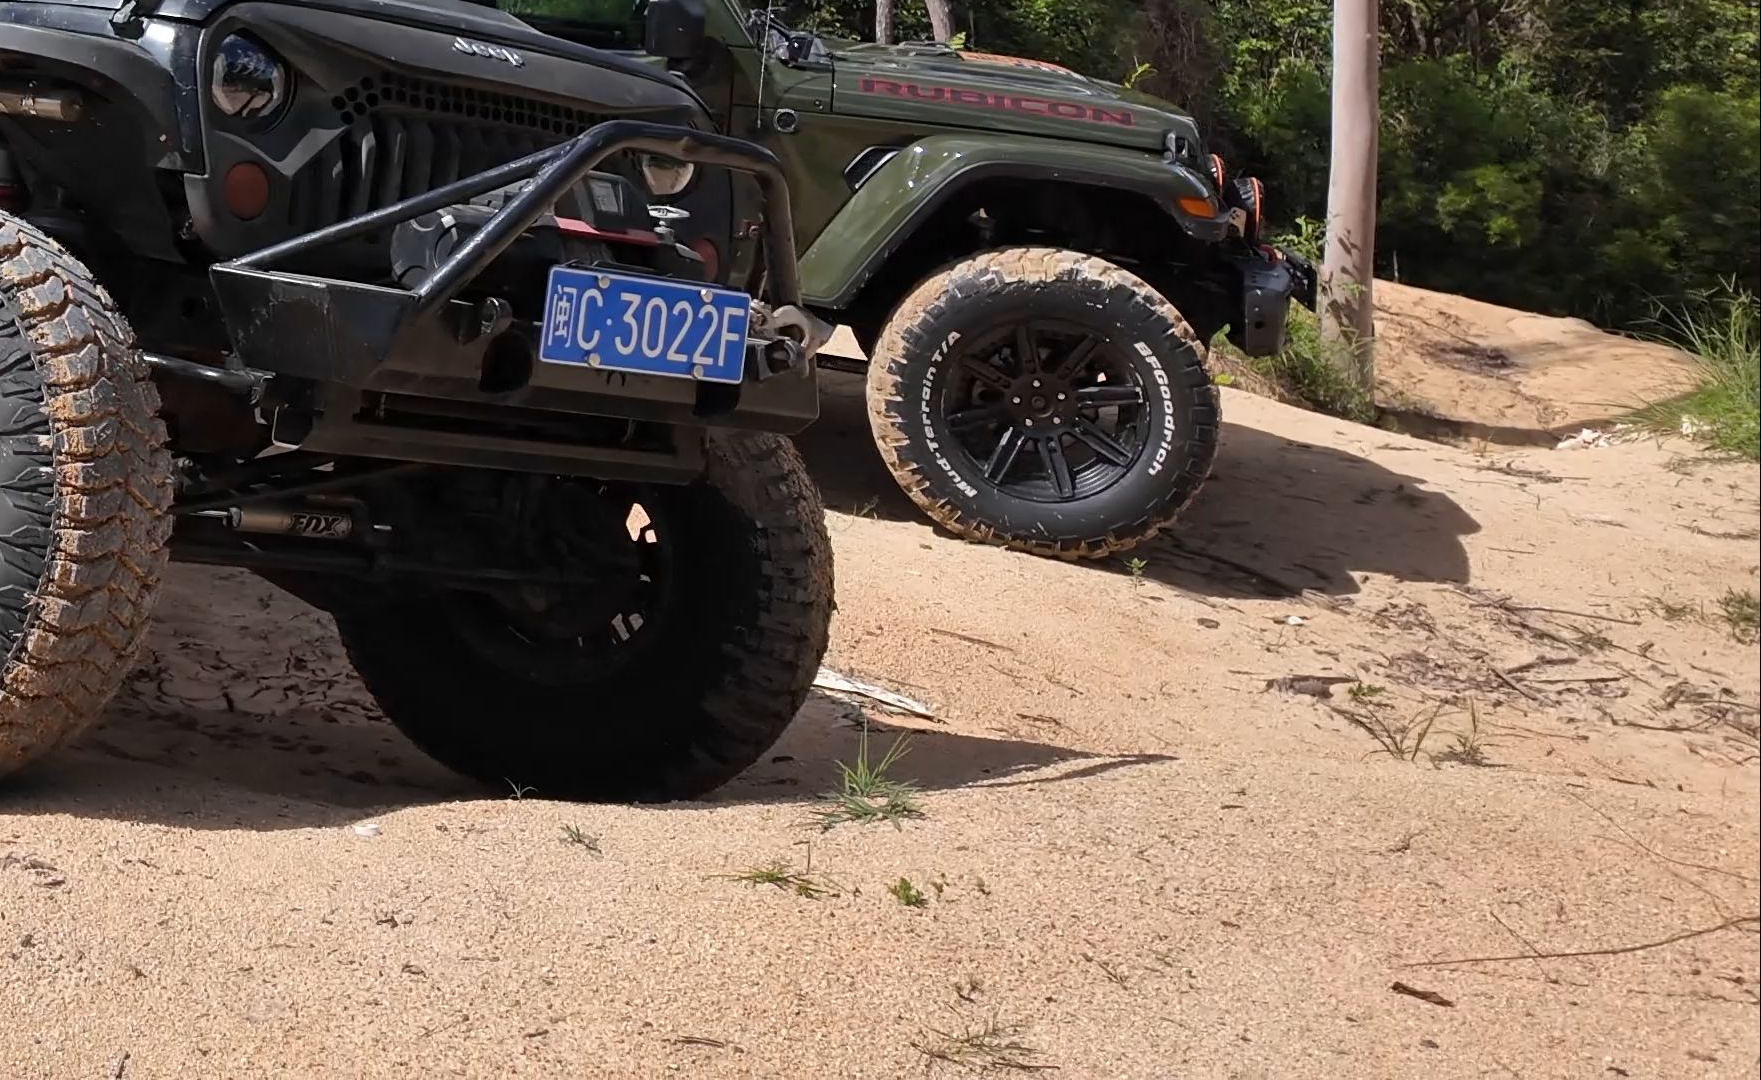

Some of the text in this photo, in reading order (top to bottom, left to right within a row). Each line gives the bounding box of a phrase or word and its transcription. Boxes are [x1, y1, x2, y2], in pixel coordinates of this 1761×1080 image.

[451, 36, 524, 66] Jeep
[858, 77, 1135, 127] RUBICON
[931, 331, 962, 363] T/A
[1133, 341, 1175, 476] BFGoodrich
[291, 512, 342, 536] FOX
